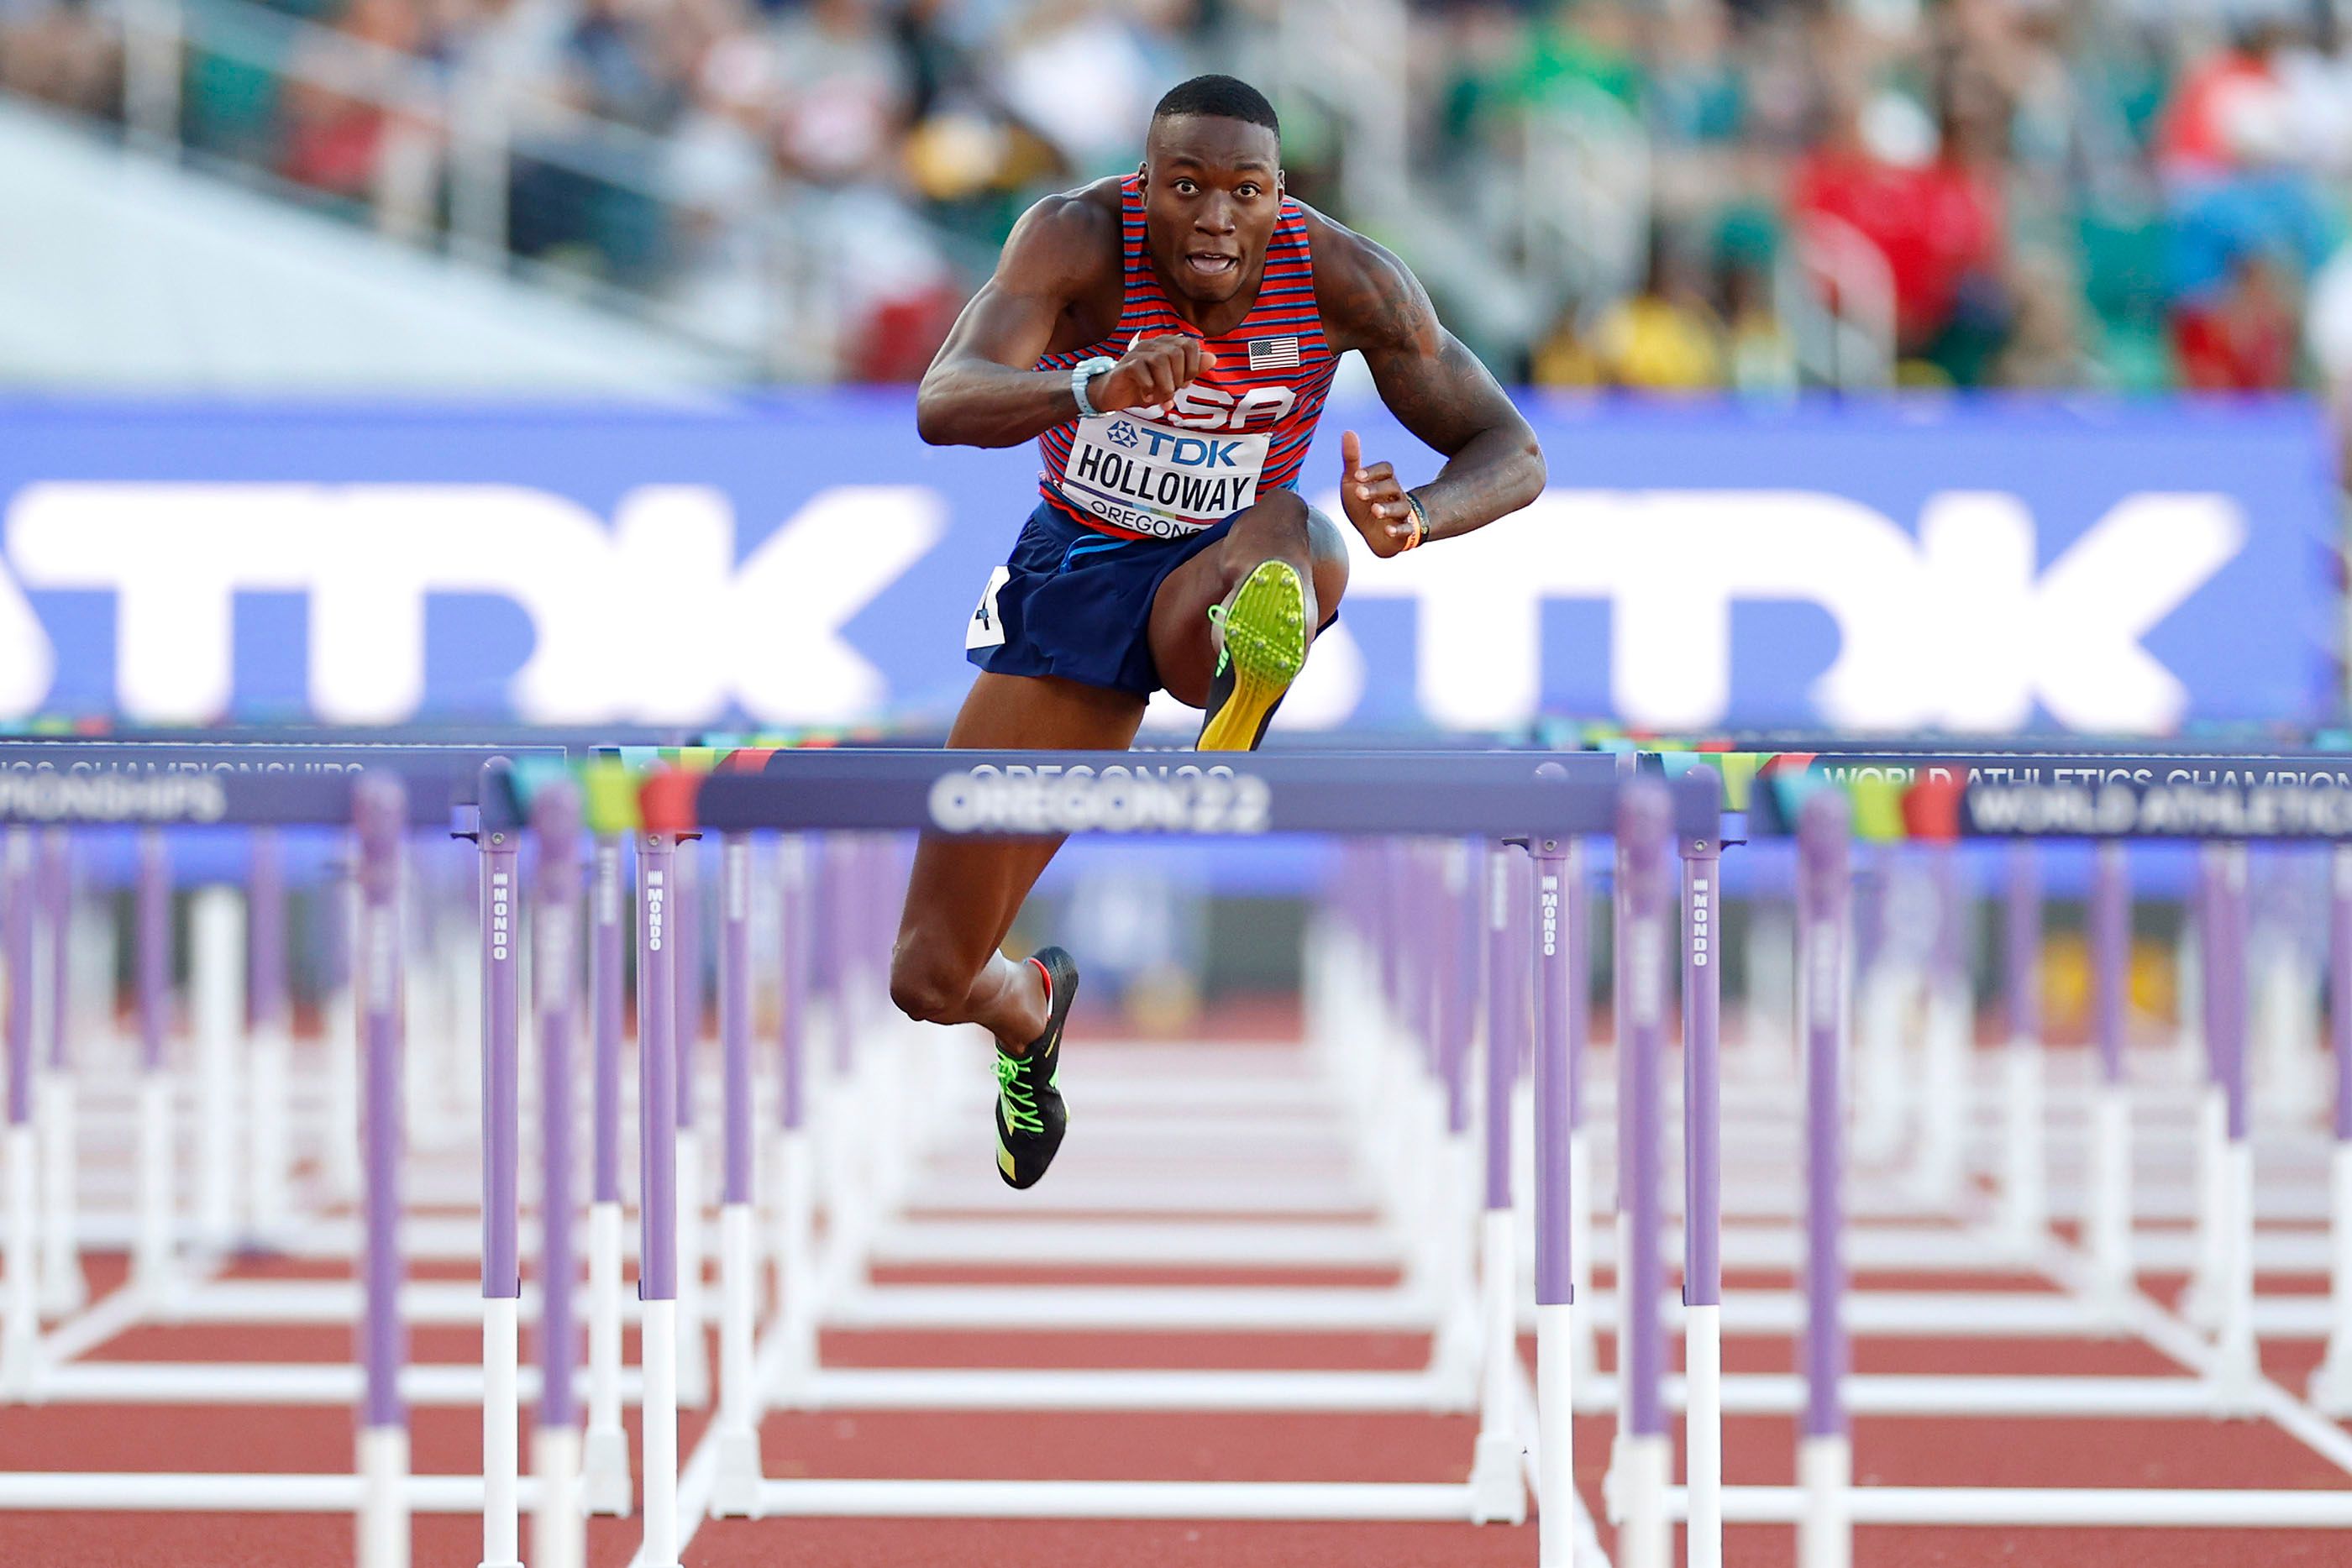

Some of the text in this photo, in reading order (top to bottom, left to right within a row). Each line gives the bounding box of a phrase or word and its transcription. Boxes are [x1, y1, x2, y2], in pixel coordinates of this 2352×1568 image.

[1122, 382, 1296, 429] SA
[1077, 443, 1250, 512] HOLLOWAY
[1141, 427, 1243, 468] TDK
[5, 480, 951, 726] TDK
[493, 888, 507, 960] MONDO
[648, 889, 663, 951] MONDO
[1541, 894, 1558, 956] MONDO
[1693, 894, 1708, 966] MONDO
